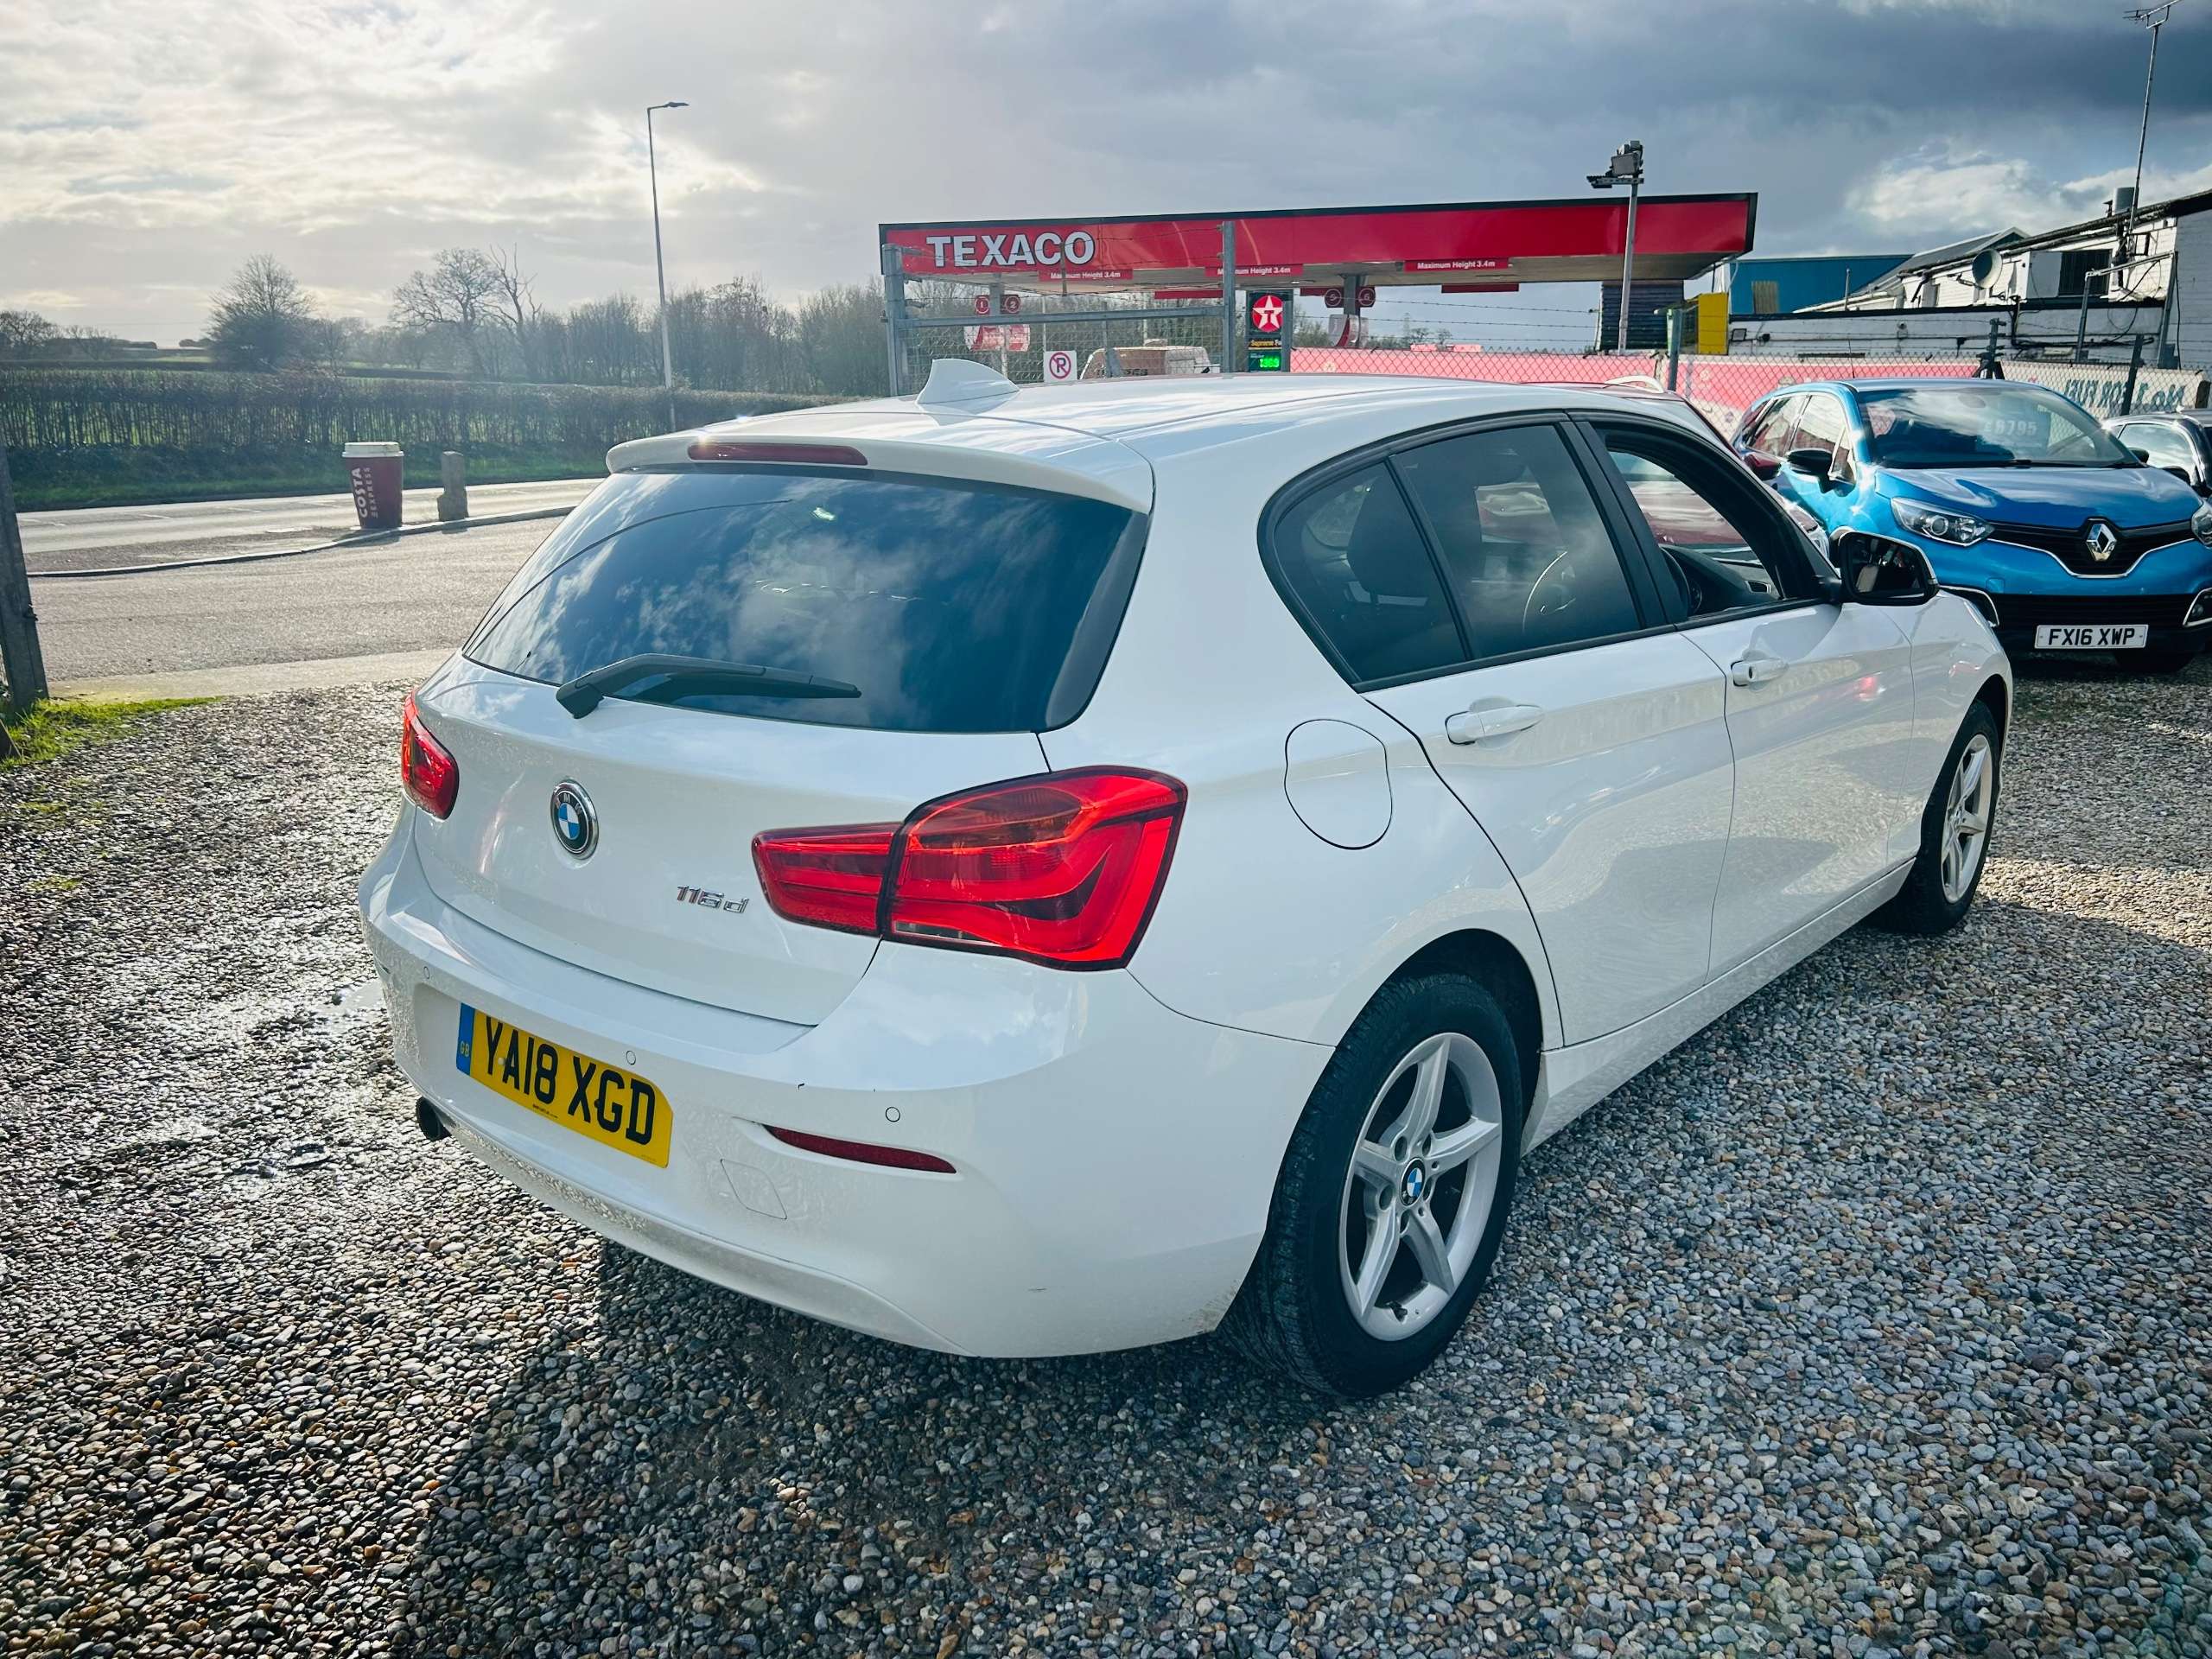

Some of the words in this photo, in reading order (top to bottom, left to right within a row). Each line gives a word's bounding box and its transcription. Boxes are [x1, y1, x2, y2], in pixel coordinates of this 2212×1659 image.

[925, 232, 1096, 268] TEXACO
[1082, 271, 1103, 280] Height
[1250, 267, 1272, 276] Height
[351, 467, 368, 518] COSTA
[364, 467, 378, 512] EXPRESS
[2048, 628, 2094, 645] FX16
[2097, 627, 2135, 645] XWP
[677, 885, 750, 914] 116d
[460, 1039, 470, 1058] GB
[486, 1015, 559, 1105] YA18
[567, 1055, 657, 1147] XGD
